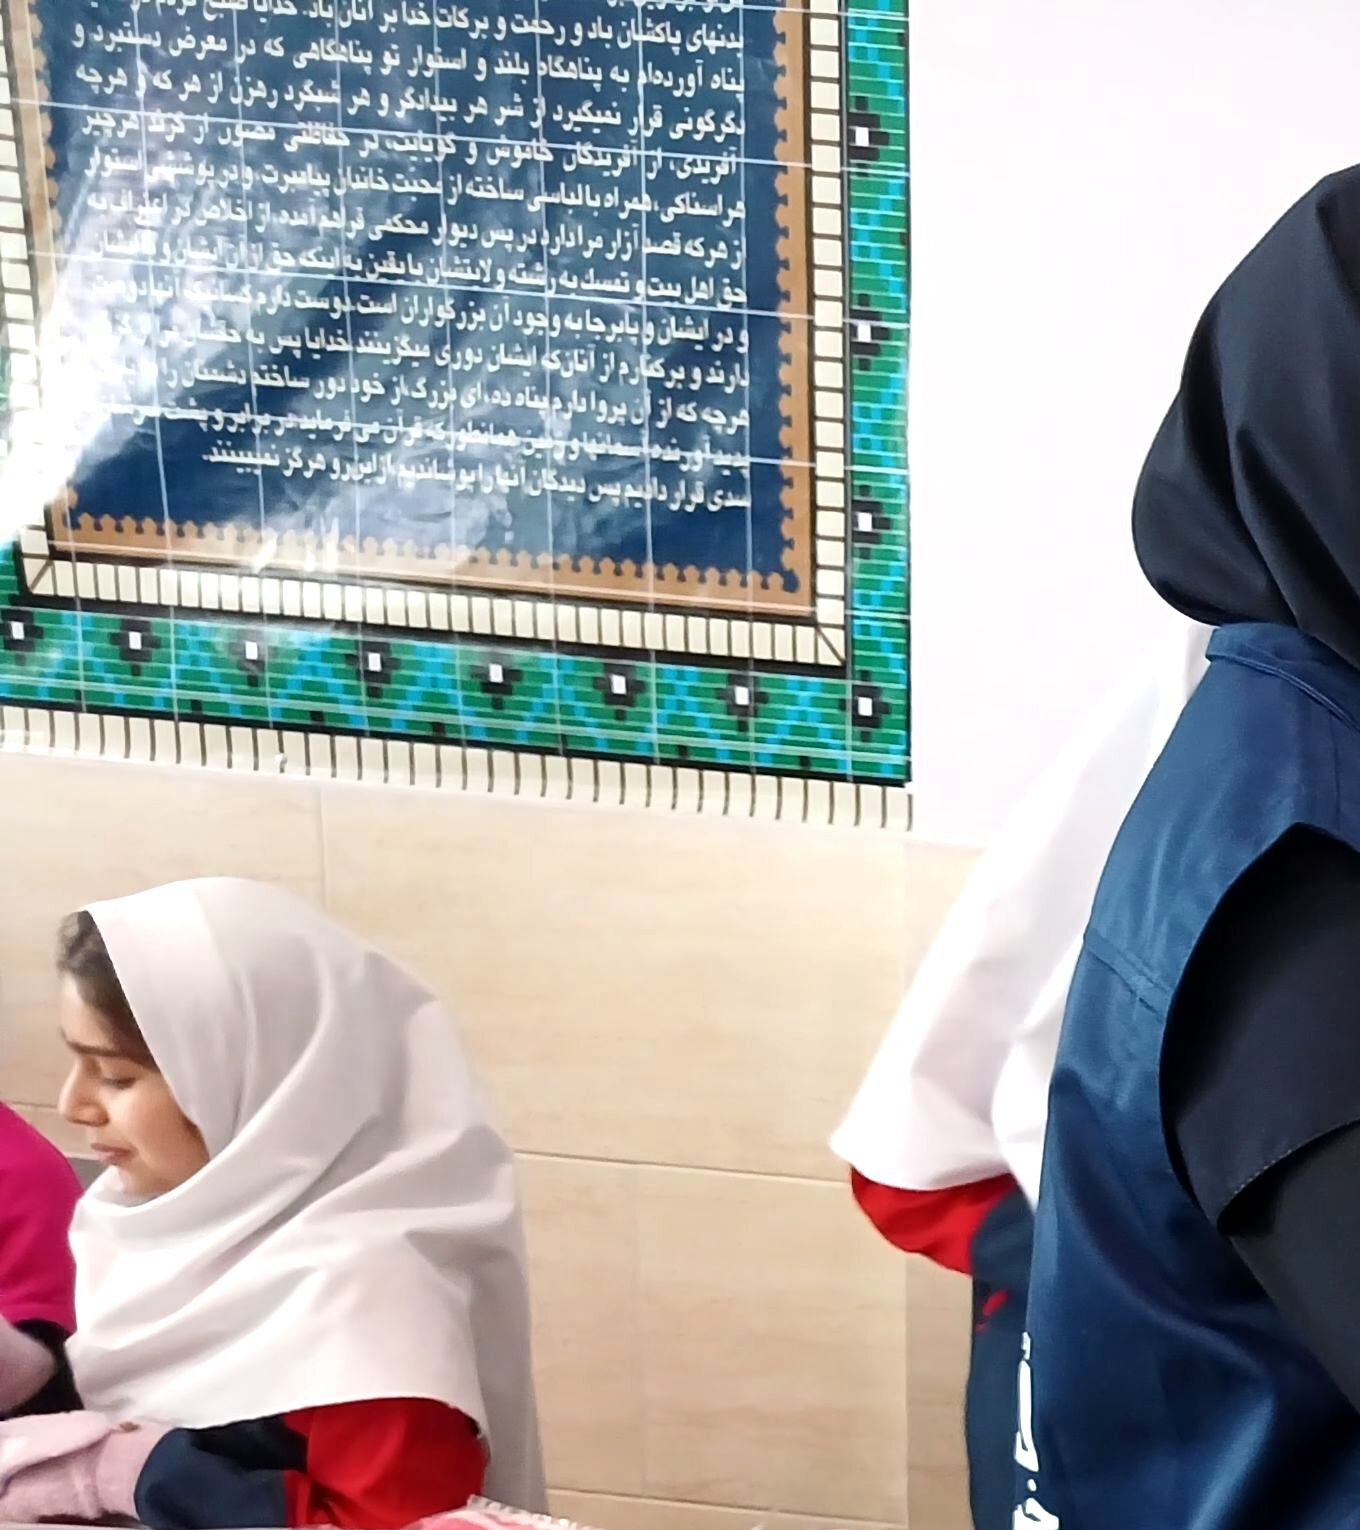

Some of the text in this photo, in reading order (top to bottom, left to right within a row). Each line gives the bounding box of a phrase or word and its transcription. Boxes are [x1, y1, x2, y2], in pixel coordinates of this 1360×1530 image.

[379, 1, 744, 58] بدنهای پاکشان باد و رحمت و برکات خدا بر
[72, 21, 745, 103] پناه به پناهگاه بلند و استوار تو پناهگاهی که در معرض دستبرد و
[136, 73, 146, 99] و
[153, 69, 172, 89] که
[179, 74, 201, 101] هر
[208, 71, 223, 104] از
[230, 76, 278, 109] رهزن
[284, 79, 340, 112] شبگرد
[347, 86, 371, 115] هر
[377, 93, 389, 116] و
[395, 86, 457, 121] بیدادگر
[464, 96, 488, 123] هر
[494, 93, 524, 126] شر
[529, 96, 545, 128] از
[628, 103, 663, 137] قرار
[669, 107, 745, 142] دگرگونی
[359, 132, 379, 158] در
[465, 140, 477, 165] و
[486, 134, 553, 169] خاموش
[219, 165, 238, 188] در
[647, 146, 662, 180] از
[242, 168, 253, 190] و
[448, 174, 462, 205] از
[466, 176, 524, 200] ساخته
[527, 182, 582, 214] لباسی
[603, 186, 652, 220] همراه
[254, 201, 271, 232] از
[369, 214, 429, 241] محکمی
[432, 213, 478, 248] دیوار
[481, 228, 514, 252] پس
[517, 229, 536, 252] در
[577, 224, 603, 258] مرا
[605, 224, 639, 261] آزار
[642, 232, 681, 255] قصد
[685, 237, 704, 257] که
[730, 236, 746, 270] از
[508, 261, 555, 296] رشته
[559, 270, 578, 296] به
[635, 280, 646, 300] و
[647, 277, 681, 305] بیت
[685, 276, 714, 304] اهل
[716, 277, 746, 309] حق
[401, 295, 486, 330] بزرگواران
[513, 311, 561, 337] وجود
[564, 312, 582, 339] به
[247, 328, 264, 352] به
[269, 331, 300, 358] پس
[644, 321, 654, 344] و
[658, 317, 709, 351] ایشان
[711, 327, 733, 351] در
[736, 329, 748, 353] و
[435, 344, 482, 370] دوری
[487, 343, 536, 376] ایشان
[600, 352, 614, 382] از
[314, 377, 345, 399] دور
[351, 373, 385, 401] خود
[688, 366, 700, 390] و
[706, 361, 748, 393] دارند
[461, 381, 481, 407] ای
[515, 385, 548, 420] پناه
[656, 397, 672, 428] از
[677, 402, 697, 421] که
[589, 482, 621, 507] پس
[670, 480, 704, 512] قرار
